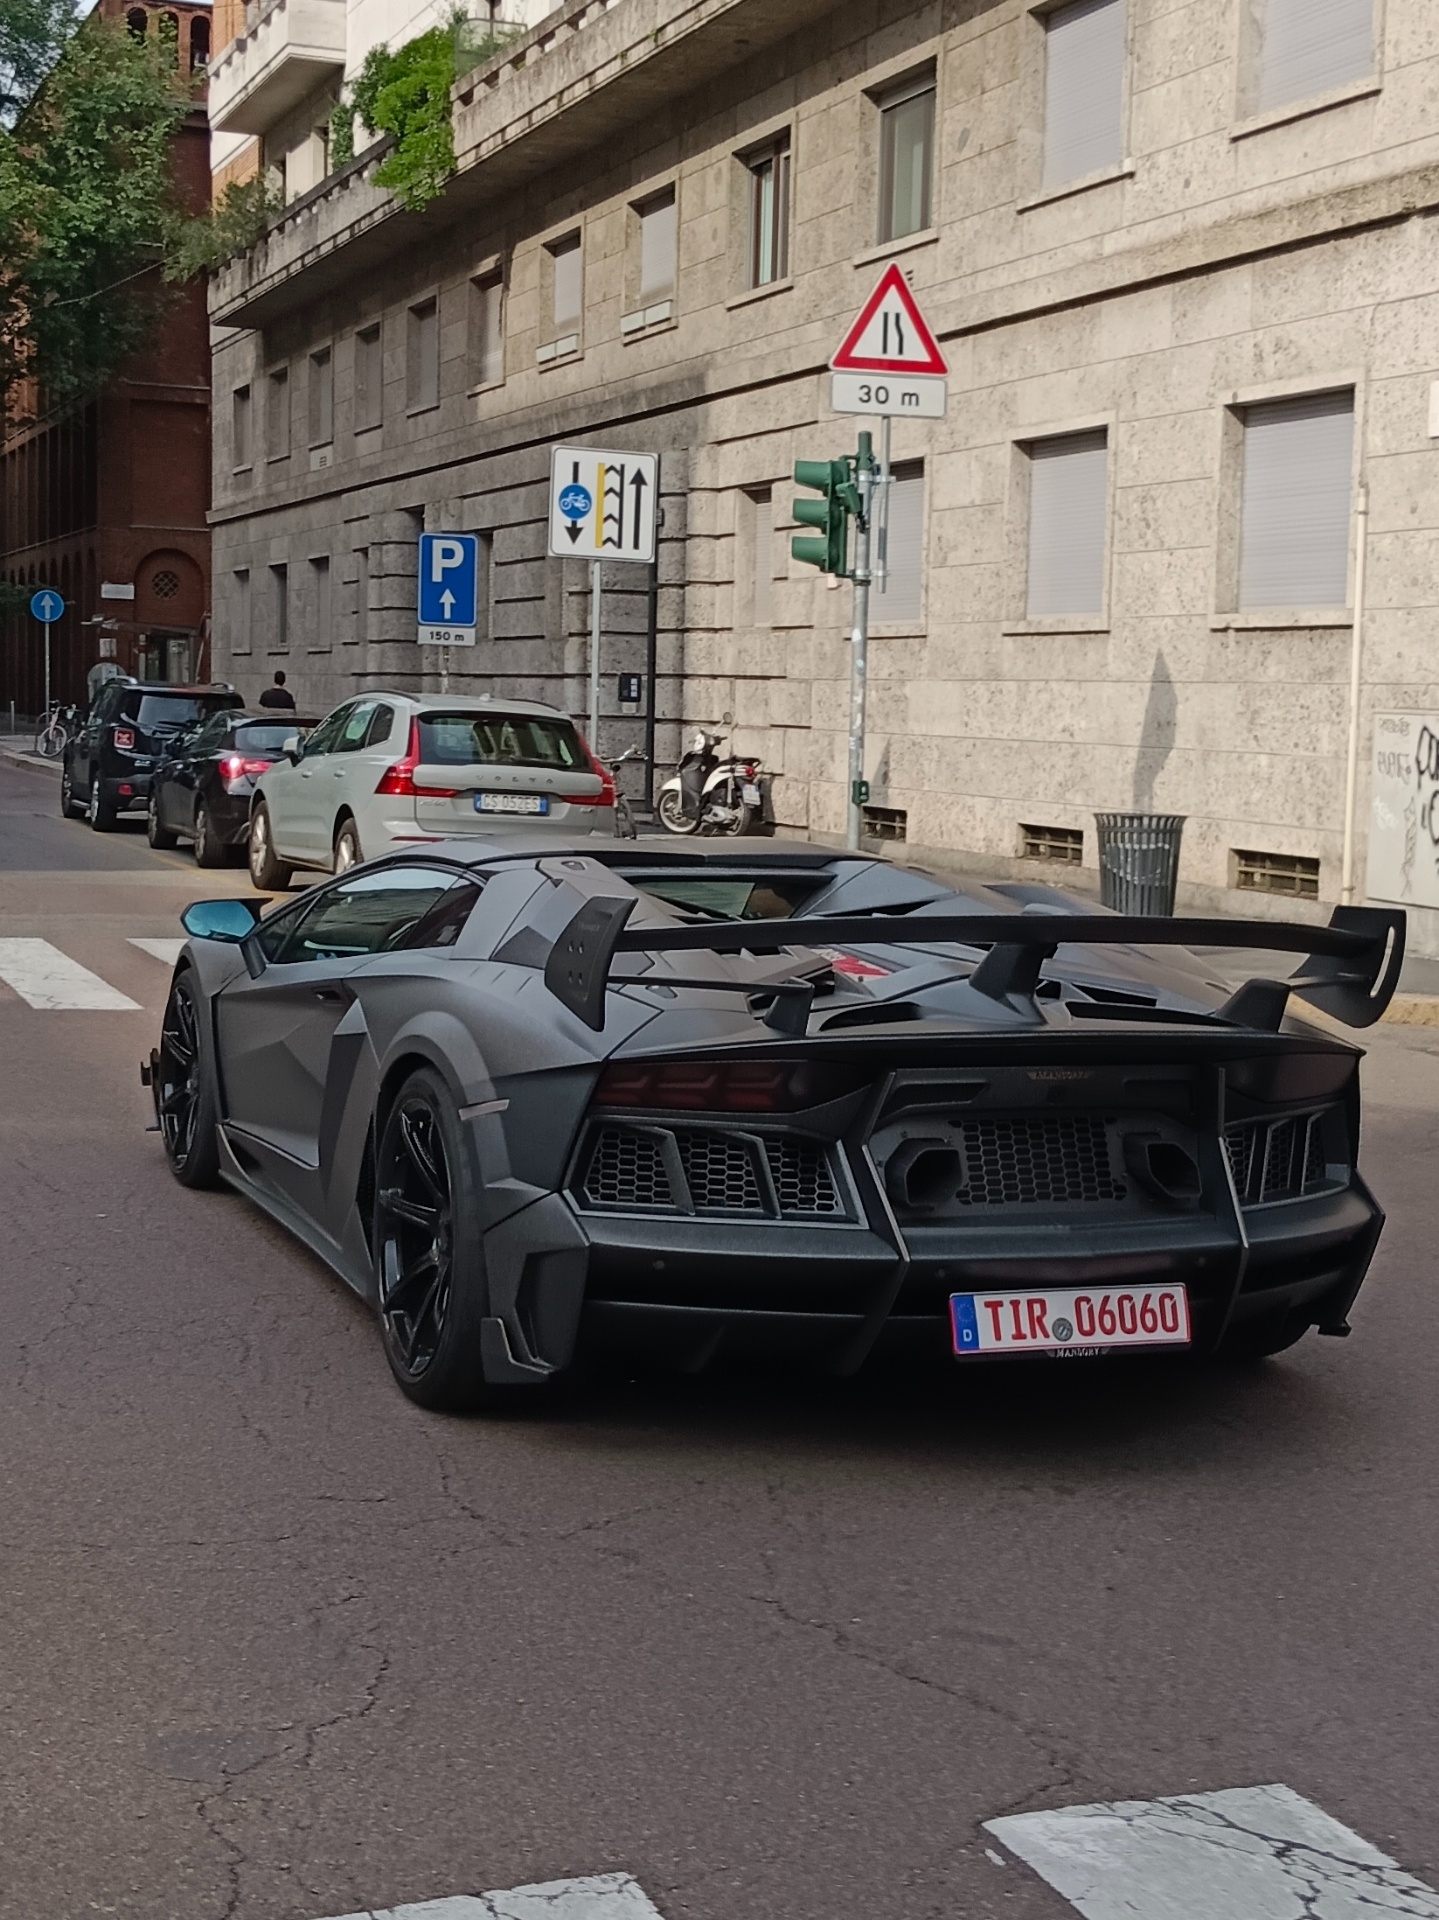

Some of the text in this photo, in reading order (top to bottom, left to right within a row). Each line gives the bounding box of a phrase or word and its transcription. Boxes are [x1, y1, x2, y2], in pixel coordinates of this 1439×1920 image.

[858, 384, 920, 407] 30 m
[432, 539, 465, 583] P
[429, 630, 465, 642] 150 m
[984, 1292, 1179, 1342] TIR 06060
[962, 1328, 973, 1342] D
